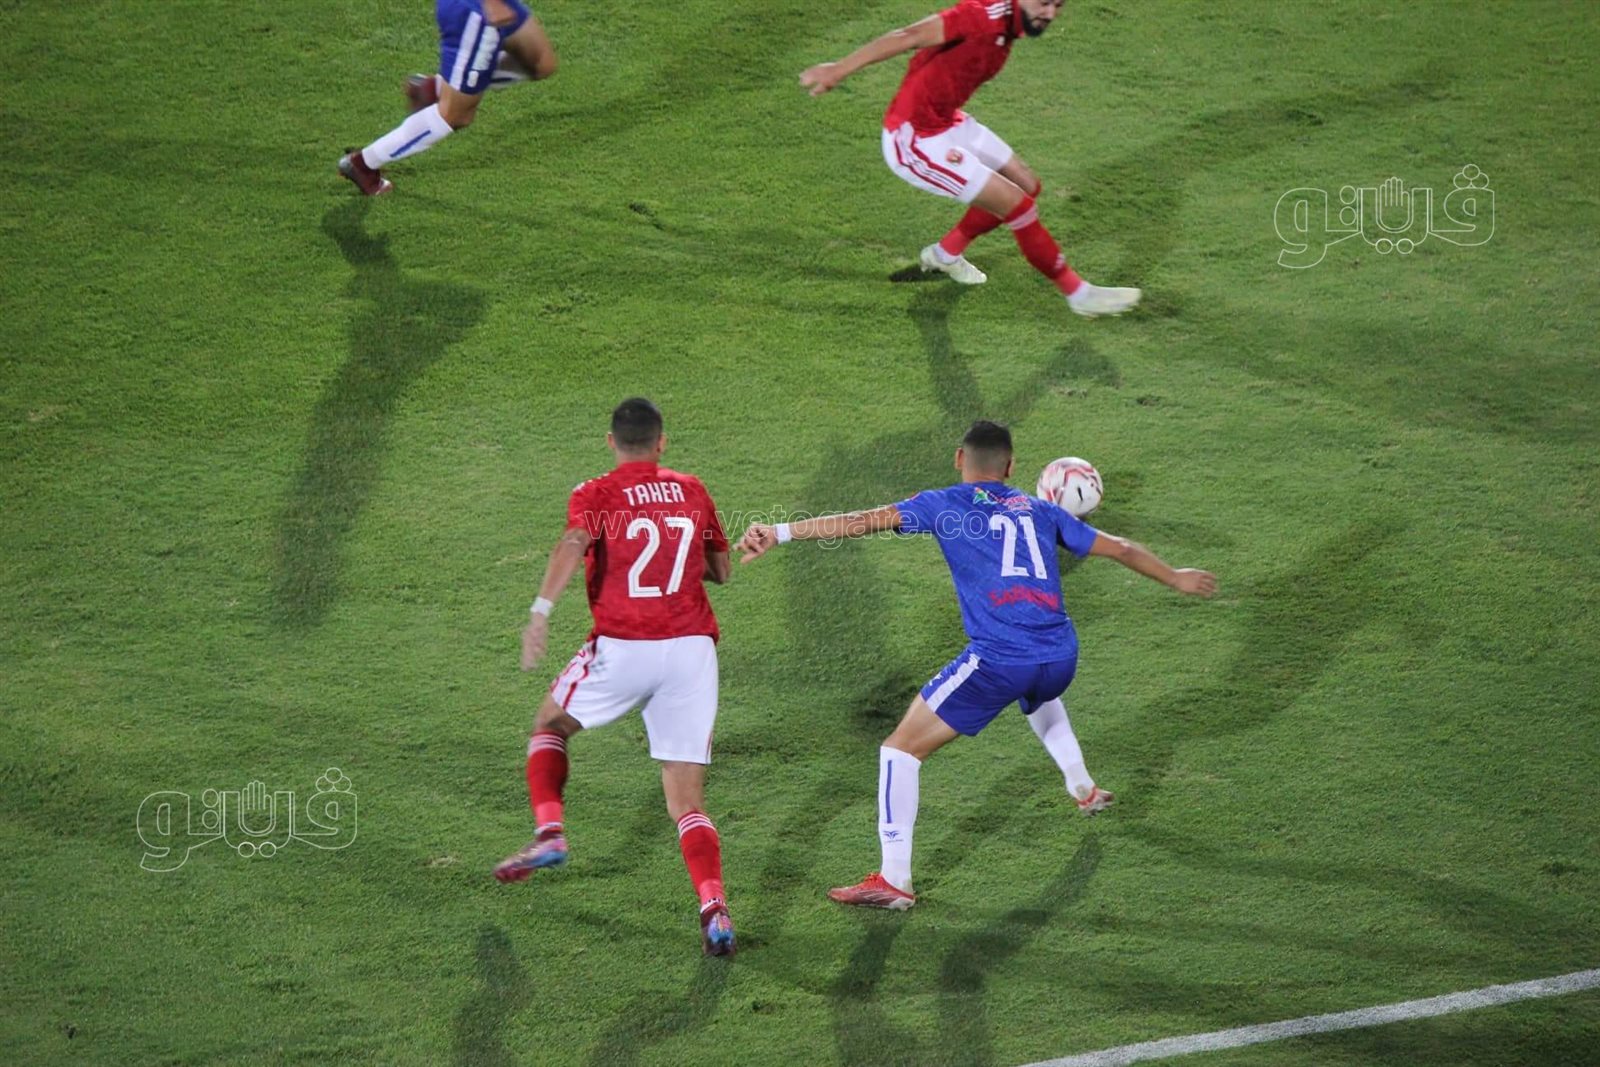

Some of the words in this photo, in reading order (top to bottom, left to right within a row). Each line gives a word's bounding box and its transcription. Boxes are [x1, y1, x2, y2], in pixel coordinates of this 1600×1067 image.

[622, 481, 686, 507] TAHER
[626, 516, 695, 598] 27
[988, 513, 1048, 580] 21
